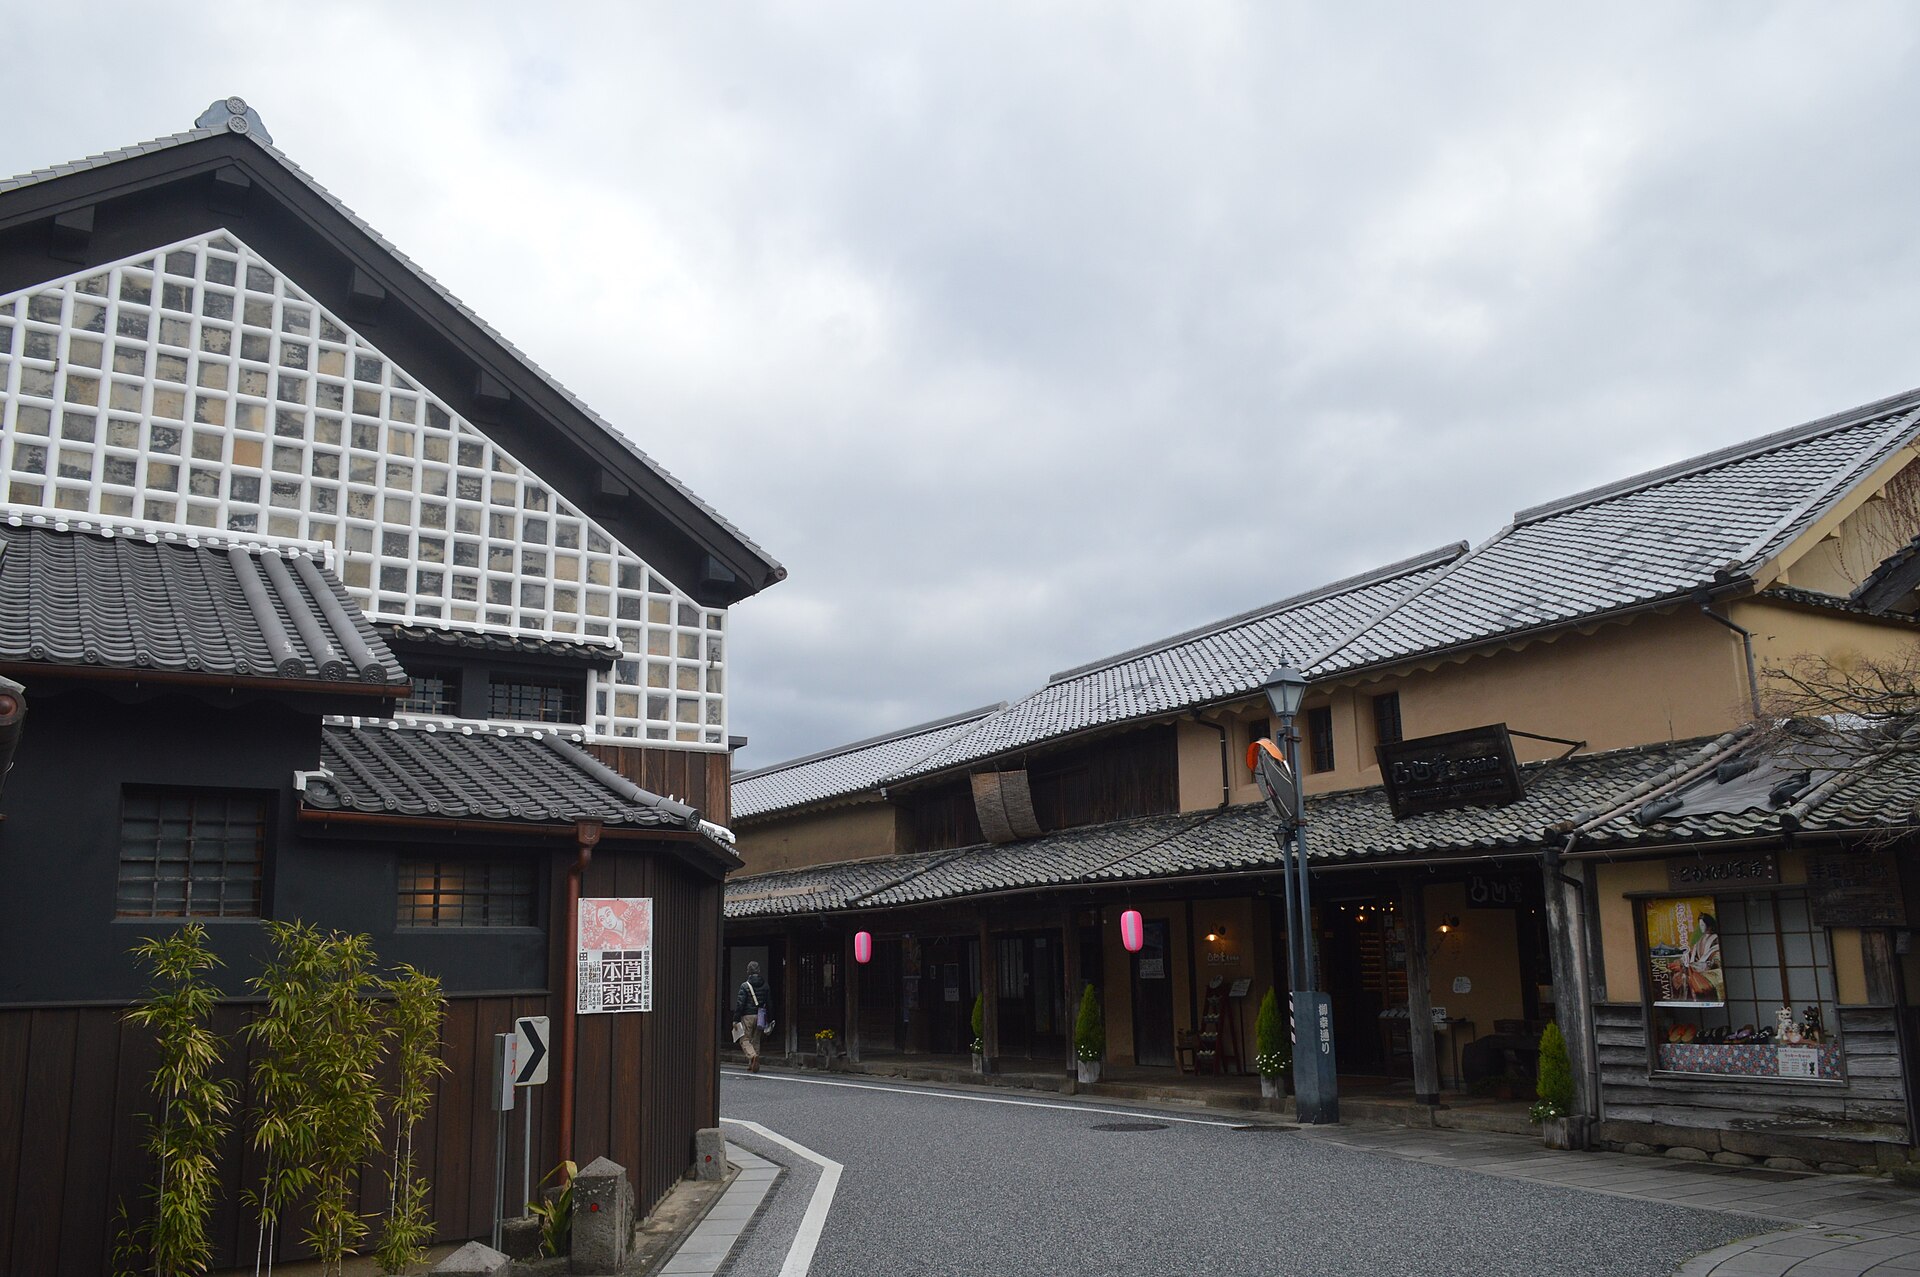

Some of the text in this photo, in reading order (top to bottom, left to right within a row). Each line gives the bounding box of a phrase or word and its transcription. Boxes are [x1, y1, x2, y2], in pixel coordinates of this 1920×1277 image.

[602, 962, 621, 1004] 本家
[624, 961, 641, 1004] 草野
[1652, 958, 1660, 981] HINA
[1659, 958, 1670, 1000] MATSURI
[1318, 1003, 1330, 1054] 御幸通り
